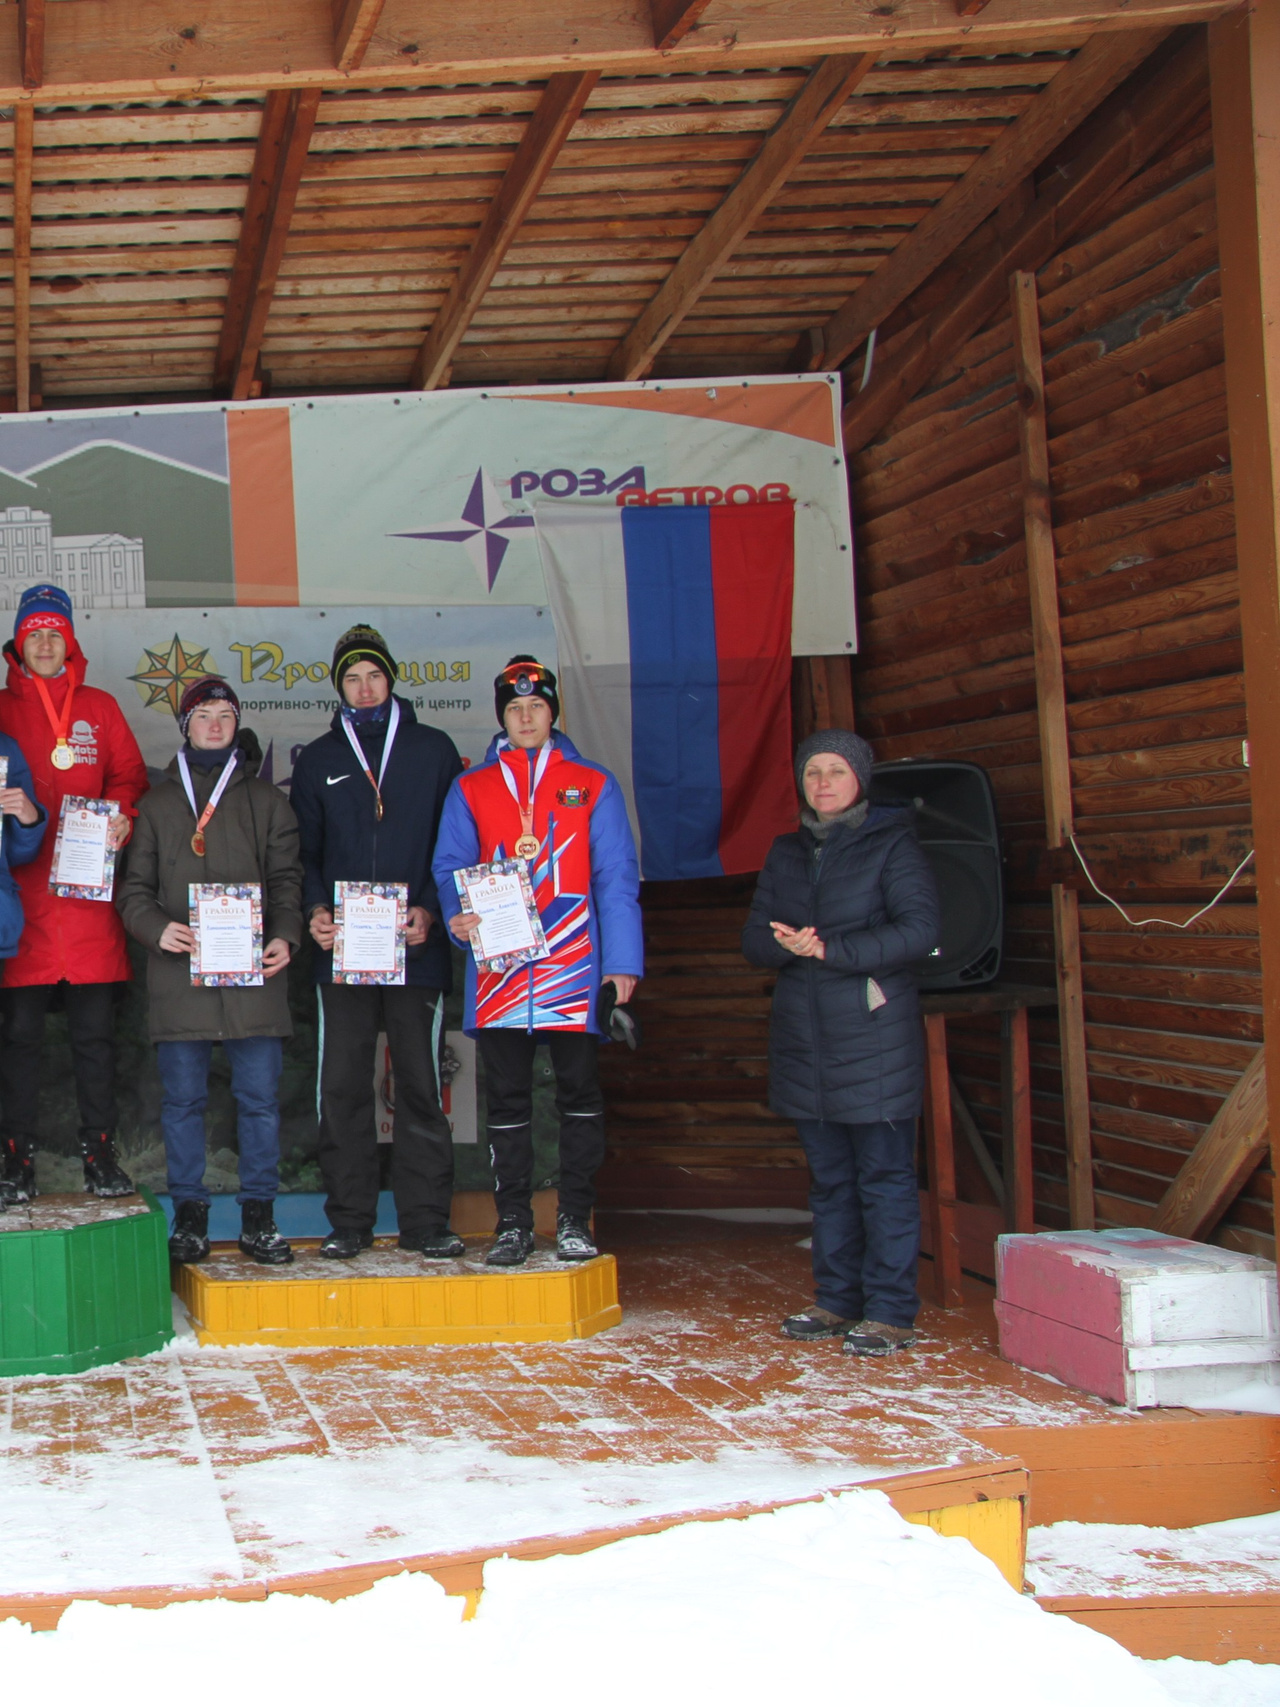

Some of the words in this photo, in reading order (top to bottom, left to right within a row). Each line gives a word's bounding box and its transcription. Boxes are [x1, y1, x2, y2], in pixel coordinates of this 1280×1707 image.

[510, 465, 646, 499] РОЗА
[228, 641, 472, 691] Проция
[428, 697, 472, 712] центр
[67, 819, 102, 830] ГРАМОТА
[474, 882, 516, 899] ГРАМОТА
[204, 907, 246, 915] ГРАМОТА
[350, 906, 391, 914] ГРАМОТА
